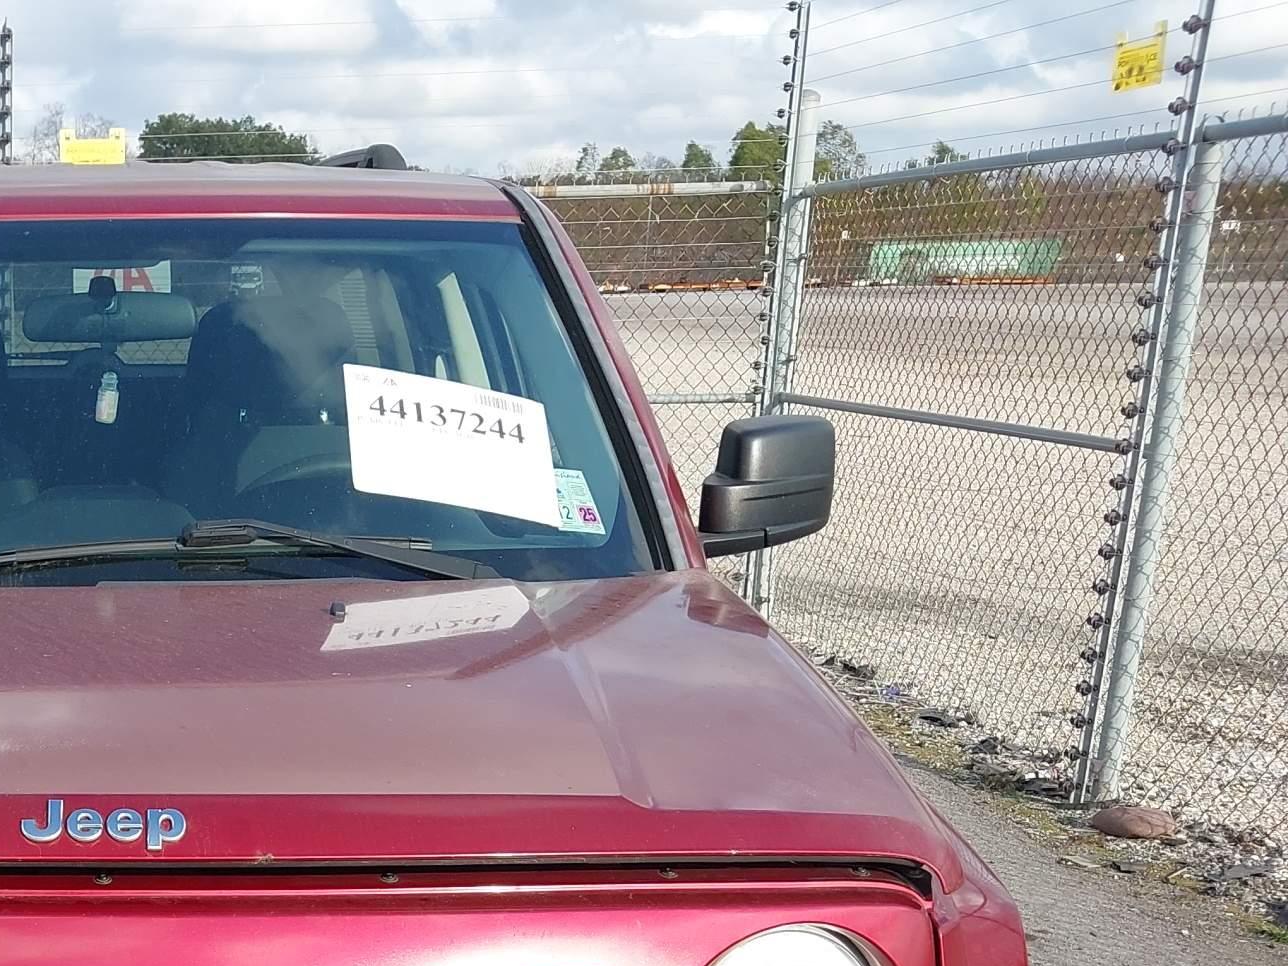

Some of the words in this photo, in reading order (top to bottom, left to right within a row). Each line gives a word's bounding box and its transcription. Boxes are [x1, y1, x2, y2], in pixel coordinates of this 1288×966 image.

[369, 395, 525, 444] 44137244
[579, 507, 597, 522] 25
[20, 799, 187, 850] Jeep
